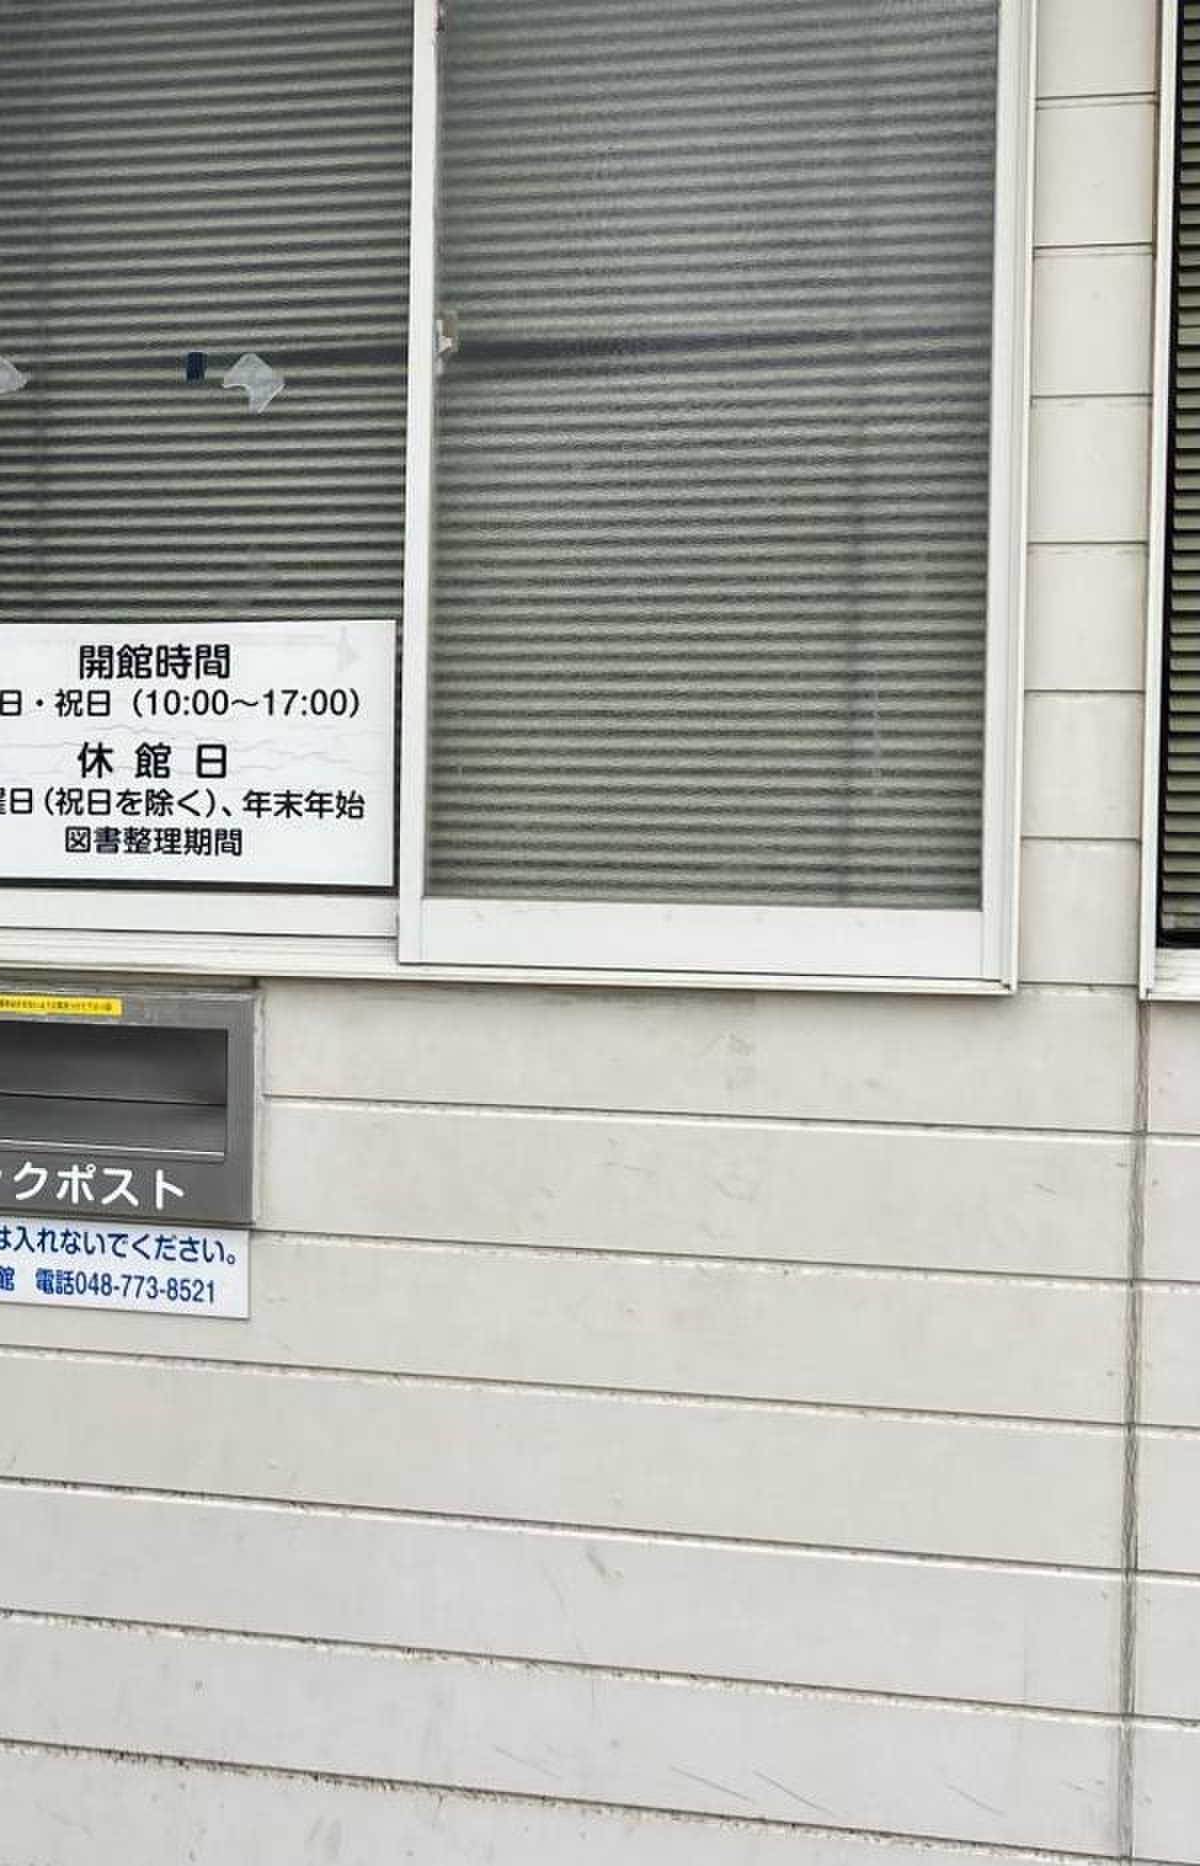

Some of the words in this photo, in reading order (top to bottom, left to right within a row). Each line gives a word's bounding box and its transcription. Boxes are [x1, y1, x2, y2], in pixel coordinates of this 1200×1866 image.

[79, 643, 231, 681] 開館時間
[64, 825, 243, 857] 図書整理期間
[35, 1268, 215, 1304] 電話048-773-8521
